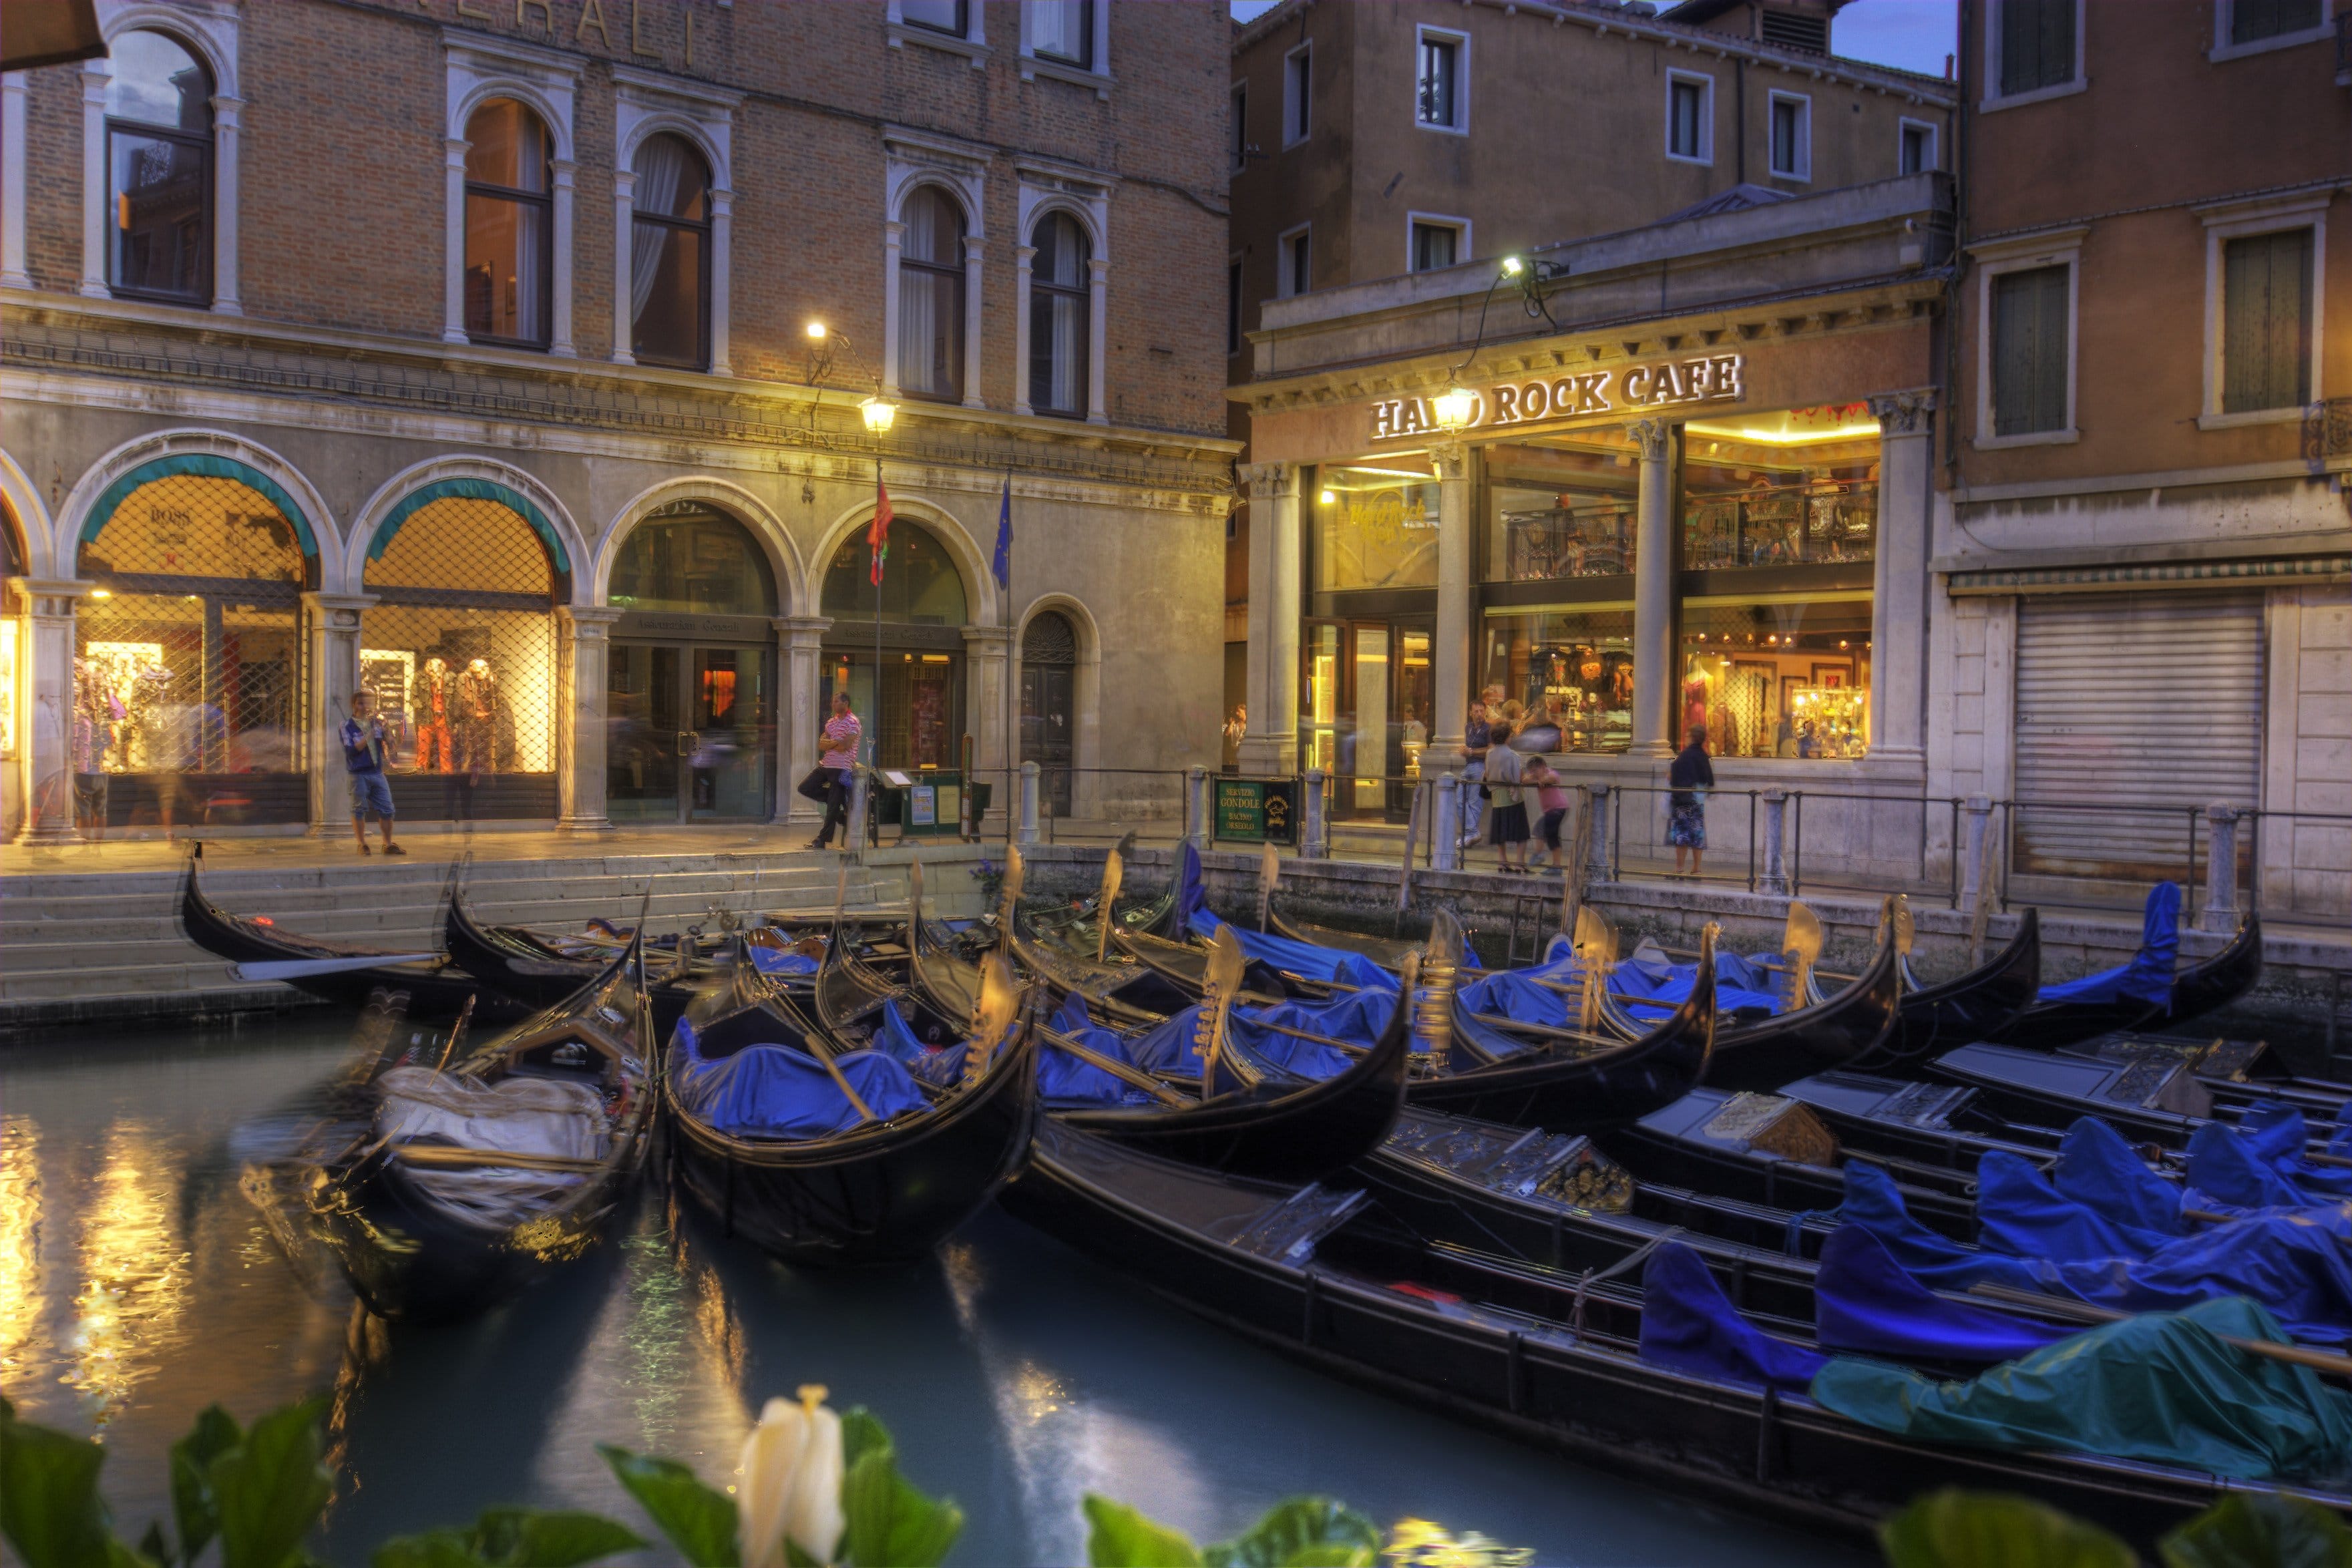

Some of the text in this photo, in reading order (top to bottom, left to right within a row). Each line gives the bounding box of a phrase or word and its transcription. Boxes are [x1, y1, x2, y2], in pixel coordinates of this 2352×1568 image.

[1370, 355, 1742, 439] HAD ROCK CAFE
[151, 508, 191, 525] BOSS
[1221, 798, 1260, 808] GONDOLE
[1228, 813, 1252, 821] BACINO
